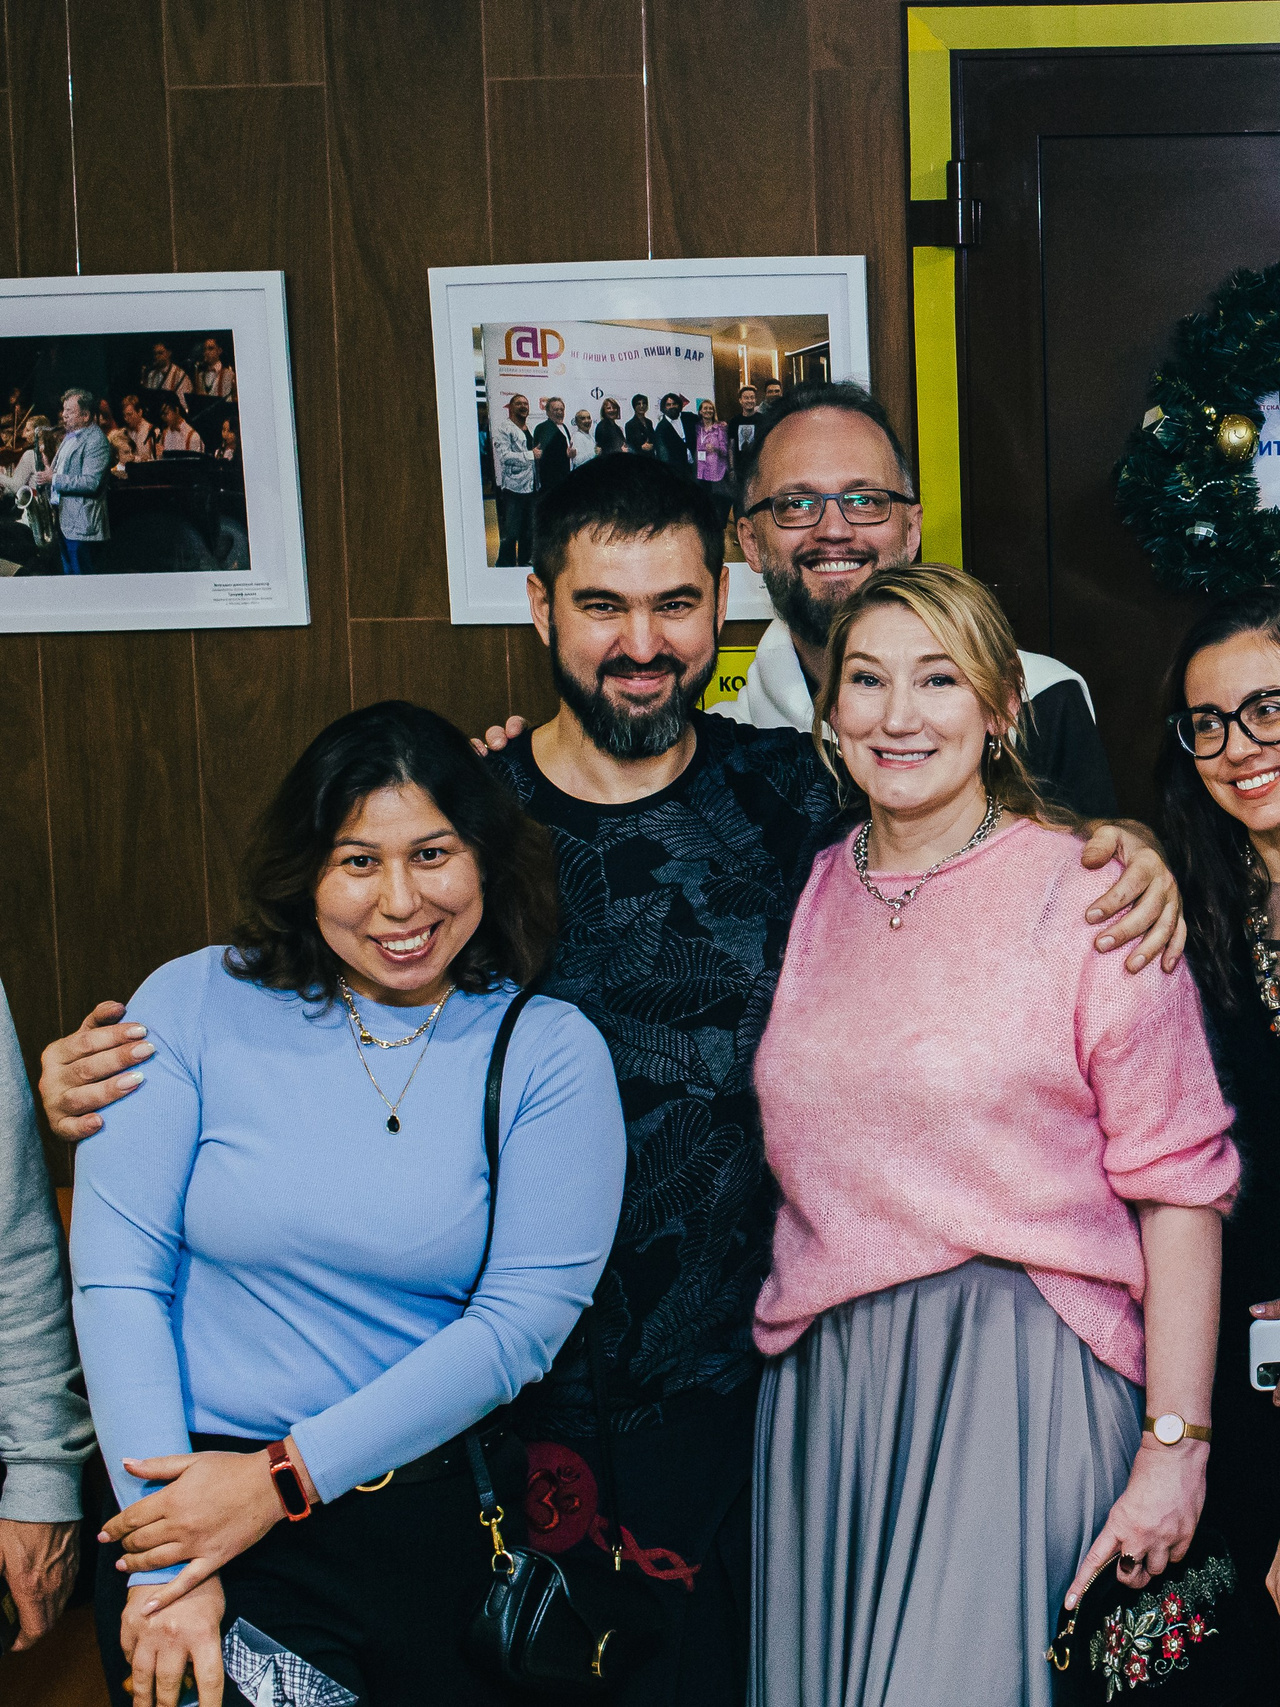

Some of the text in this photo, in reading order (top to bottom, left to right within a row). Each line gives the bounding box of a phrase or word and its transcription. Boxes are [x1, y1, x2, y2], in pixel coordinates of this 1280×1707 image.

[582, 351, 608, 363] ПИШИ
[610, 353, 616, 363] В
[643, 345, 672, 358] ПИШИ
[674, 346, 682, 358] В
[684, 348, 705, 362] ДАР
[719, 675, 747, 692] КО
